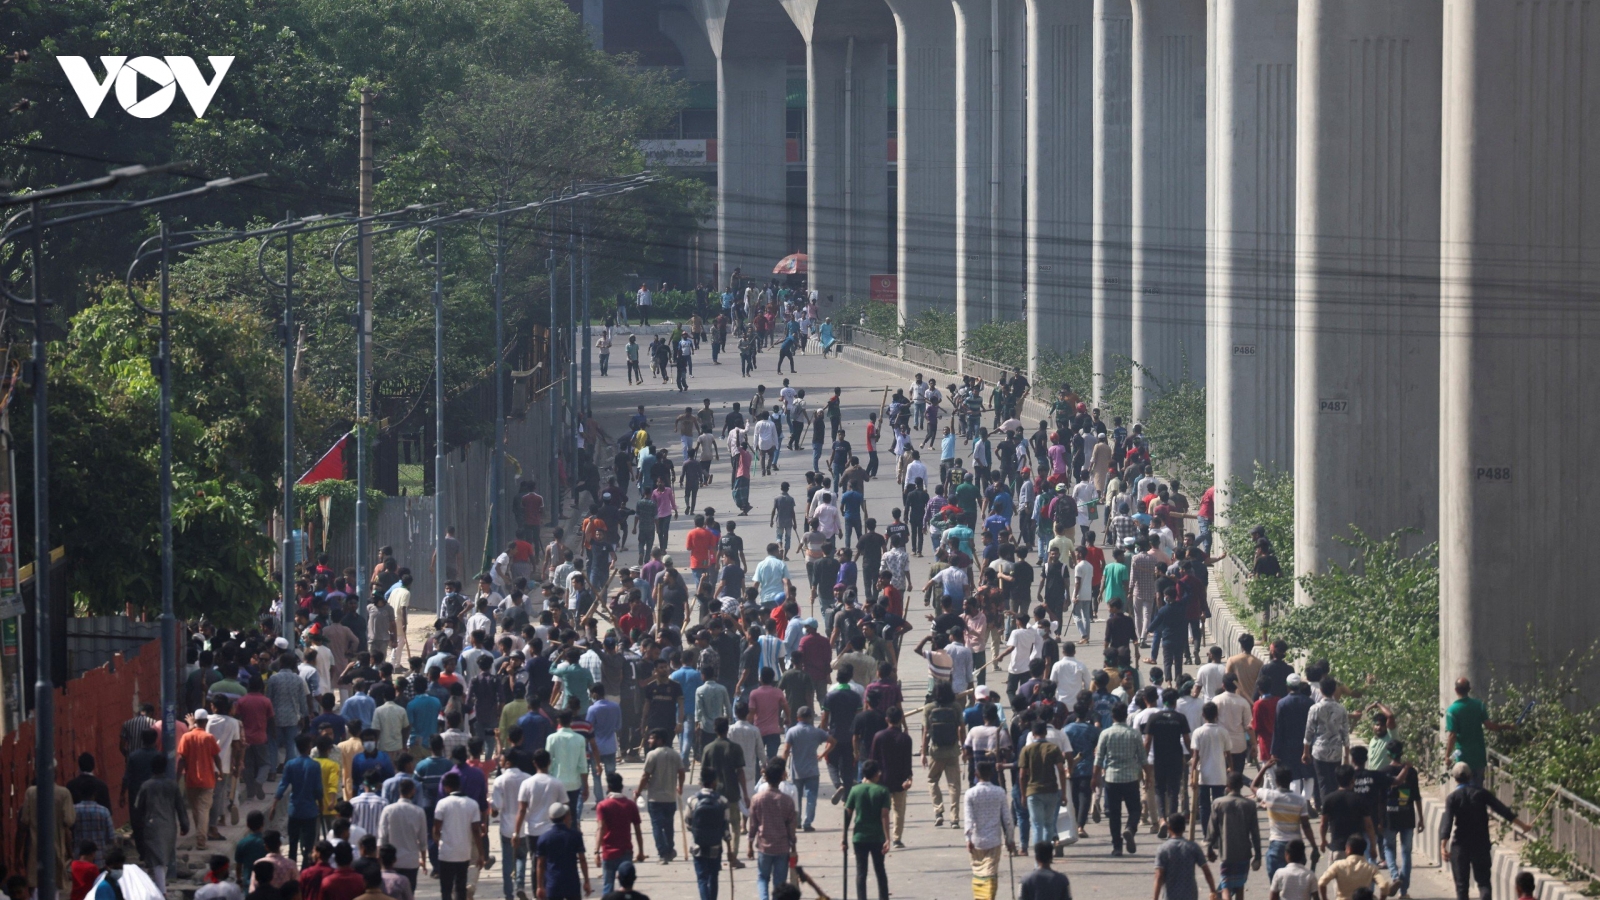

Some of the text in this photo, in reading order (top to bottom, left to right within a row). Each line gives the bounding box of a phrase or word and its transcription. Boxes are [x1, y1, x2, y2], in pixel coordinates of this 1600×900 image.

[677, 148, 705, 158] Bazar
[1234, 346, 1255, 355] P486
[1321, 401, 1347, 411] P487
[1477, 467, 1510, 480] P488
